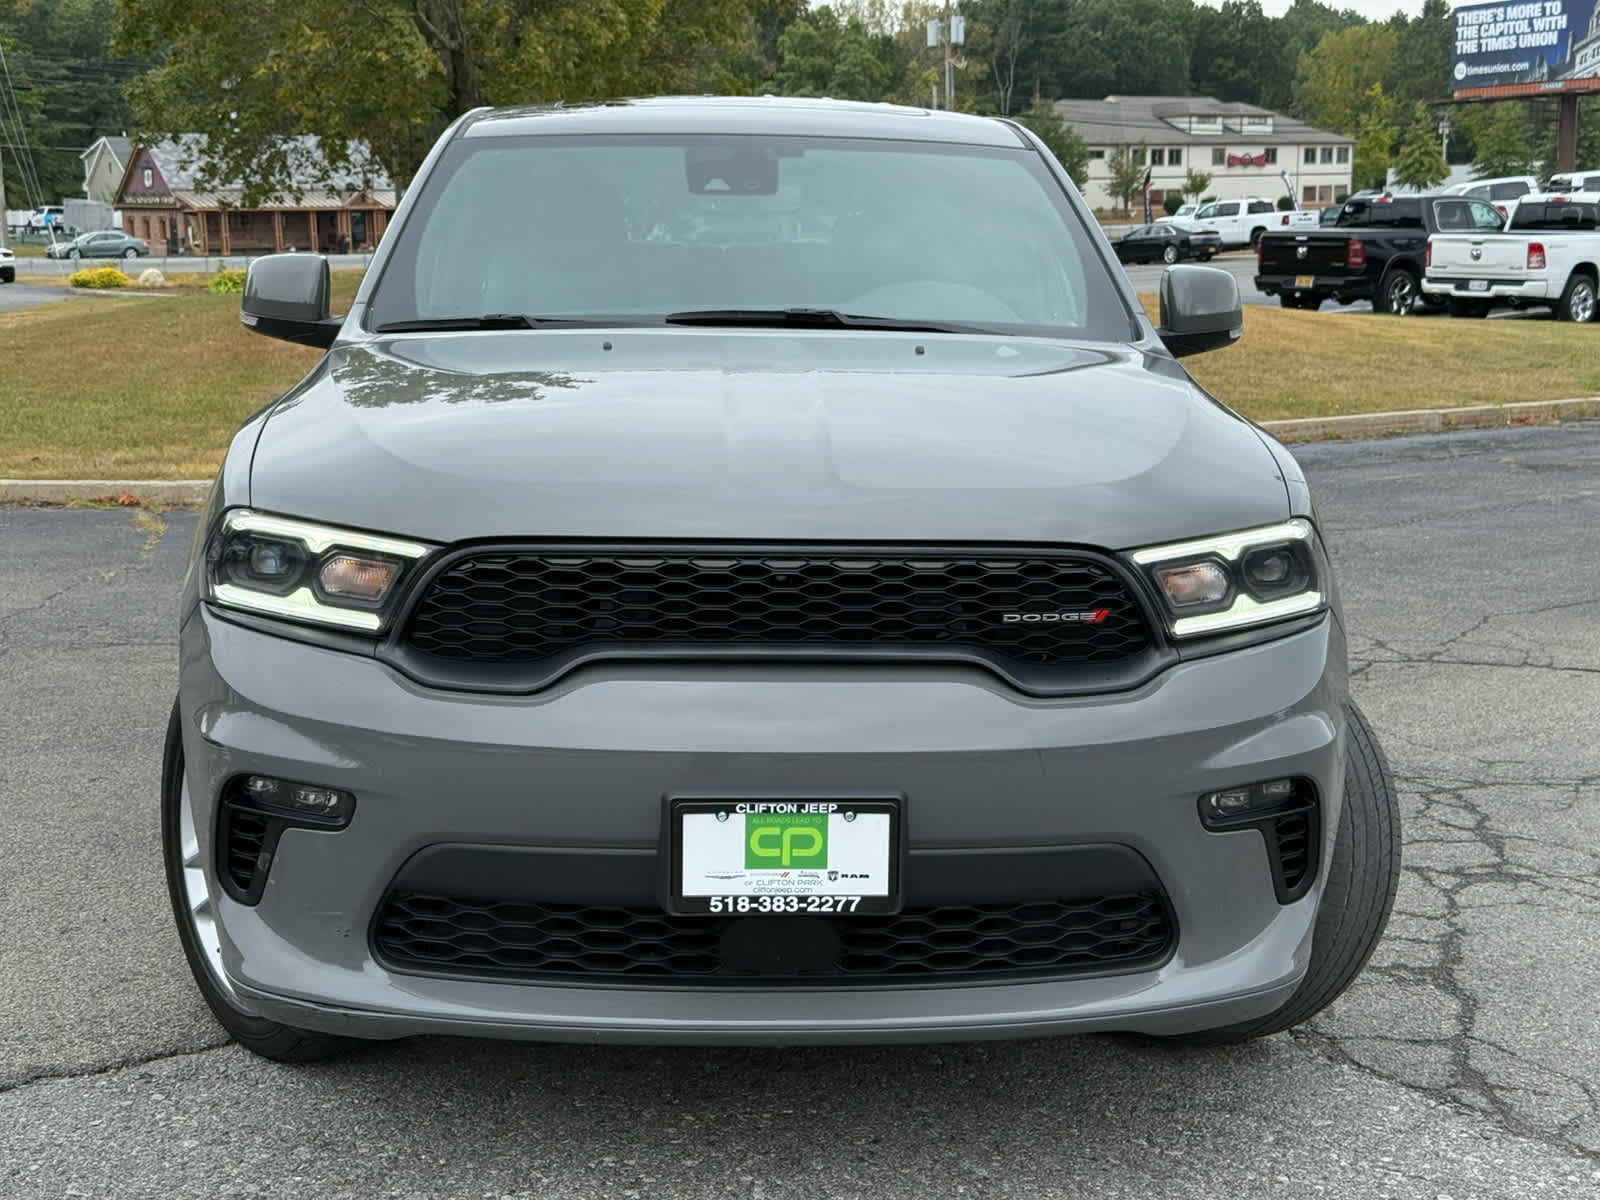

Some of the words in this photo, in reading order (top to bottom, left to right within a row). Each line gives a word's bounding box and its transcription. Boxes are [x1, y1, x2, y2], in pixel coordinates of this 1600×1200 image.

[1456, 6, 1505, 26] THERE'S
[1506, 2, 1543, 20] MORE
[1544, 0, 1563, 16] TO
[1455, 25, 1479, 41] THE
[1480, 19, 1532, 38] CAPITOL
[1532, 14, 1568, 31] WITH
[1455, 40, 1479, 55] THE
[1480, 34, 1518, 52] TIMES
[1518, 31, 1559, 48] UNION
[1466, 61, 1529, 76] timesunion.com
[1003, 612, 1096, 622] DODGE
[735, 803, 798, 814] CLIFTON
[801, 803, 838, 814] JEEP
[752, 886, 813, 894] cliftonjeep.com
[709, 897, 862, 912] 518-383-2277
